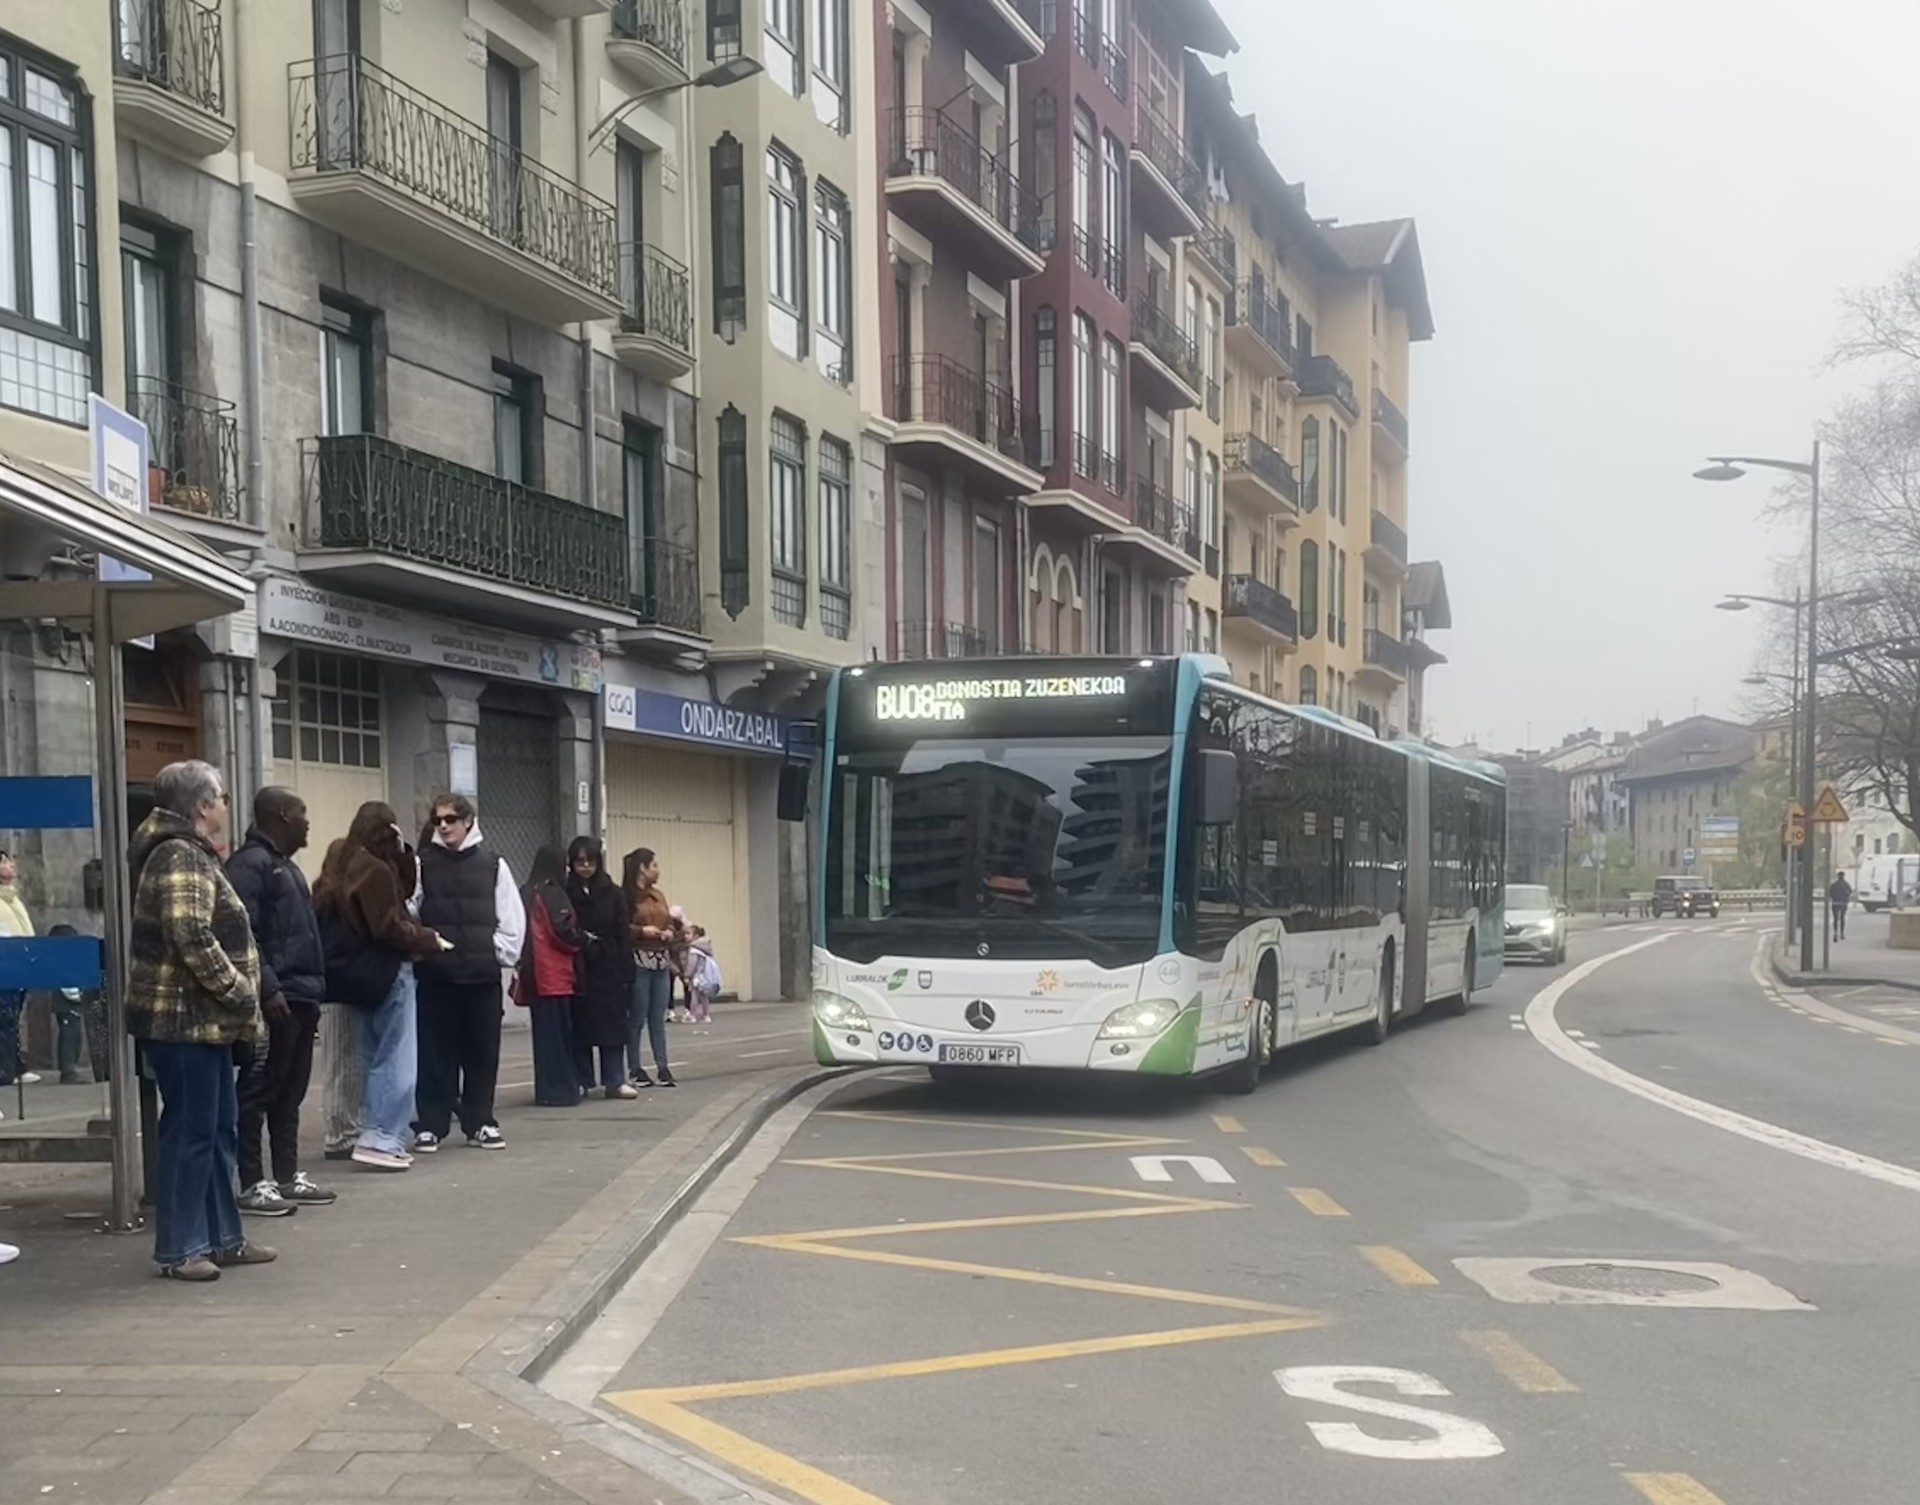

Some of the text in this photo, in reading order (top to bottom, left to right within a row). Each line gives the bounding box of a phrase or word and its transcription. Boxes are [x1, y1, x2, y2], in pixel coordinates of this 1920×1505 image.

[281, 585, 326, 605] INYECCION
[356, 635, 411, 655] CLIMATIZADOR
[935, 676, 1126, 699] DONOSTIA ZUZENEKOA
[680, 702, 783, 748] ONDARZABAL
[949, 1047, 984, 1062] 0860
[988, 1048, 1015, 1062] MFP
